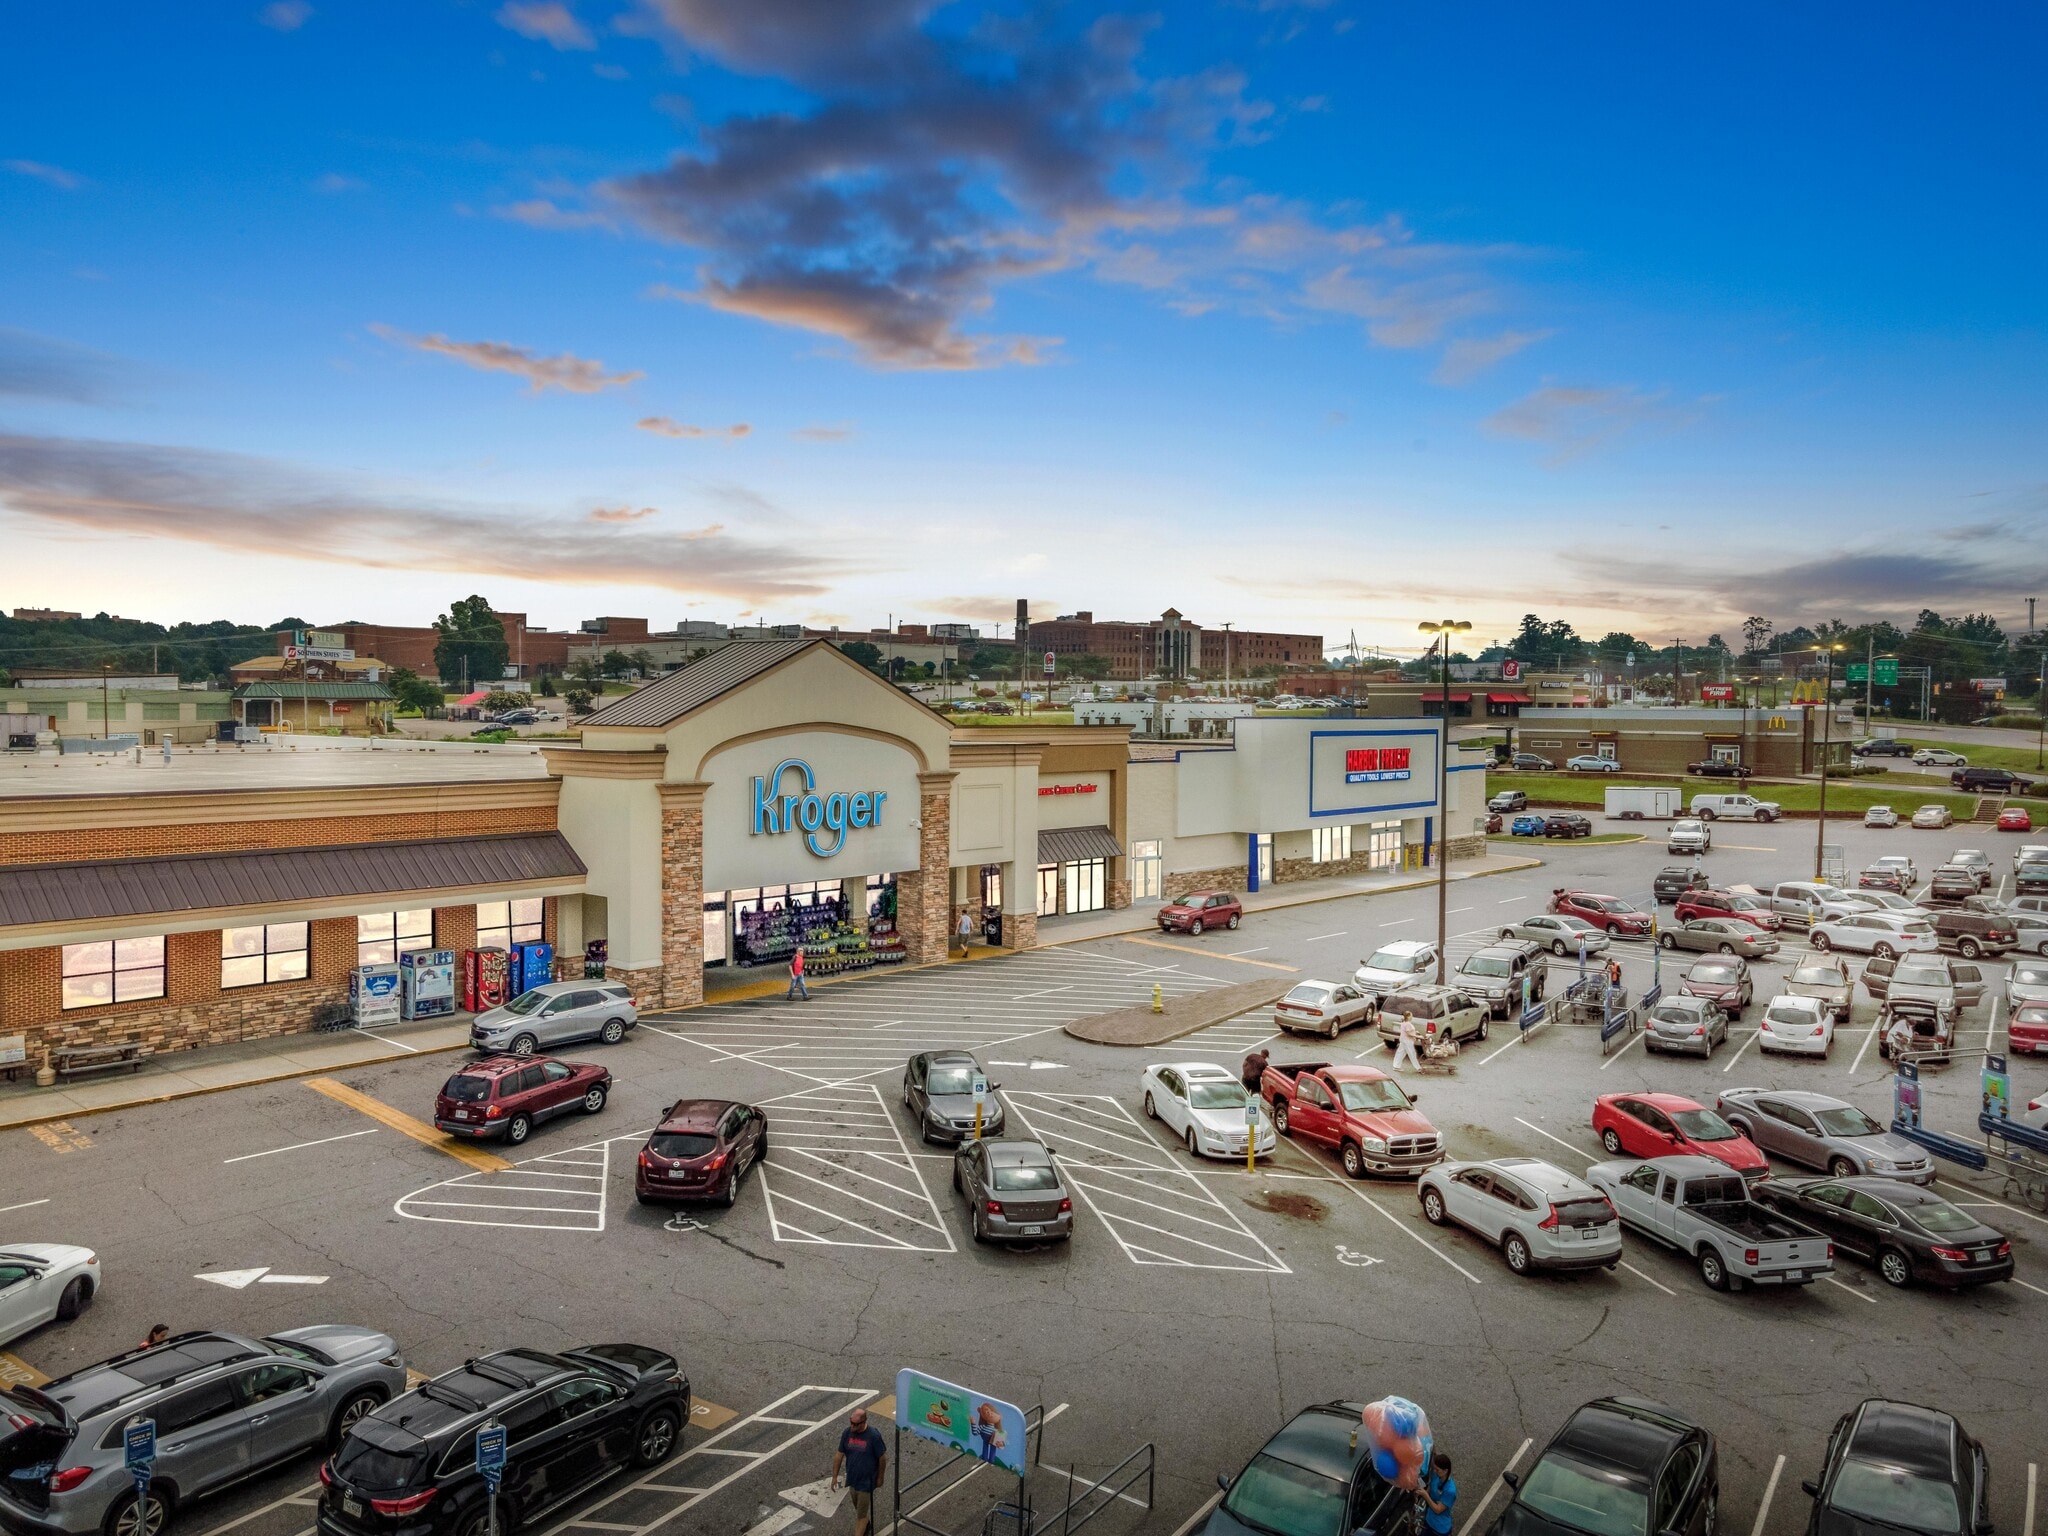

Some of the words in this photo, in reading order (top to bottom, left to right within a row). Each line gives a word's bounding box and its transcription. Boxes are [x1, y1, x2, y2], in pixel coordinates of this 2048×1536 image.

[1346, 749, 1378, 772] HARBOR
[1379, 747, 1411, 770] FREIGHT
[1349, 774, 1367, 782] QUALITY
[1367, 773, 1380, 781] TOOLS
[1380, 772, 1396, 780] LOWEST
[752, 758, 888, 858] Kroger
